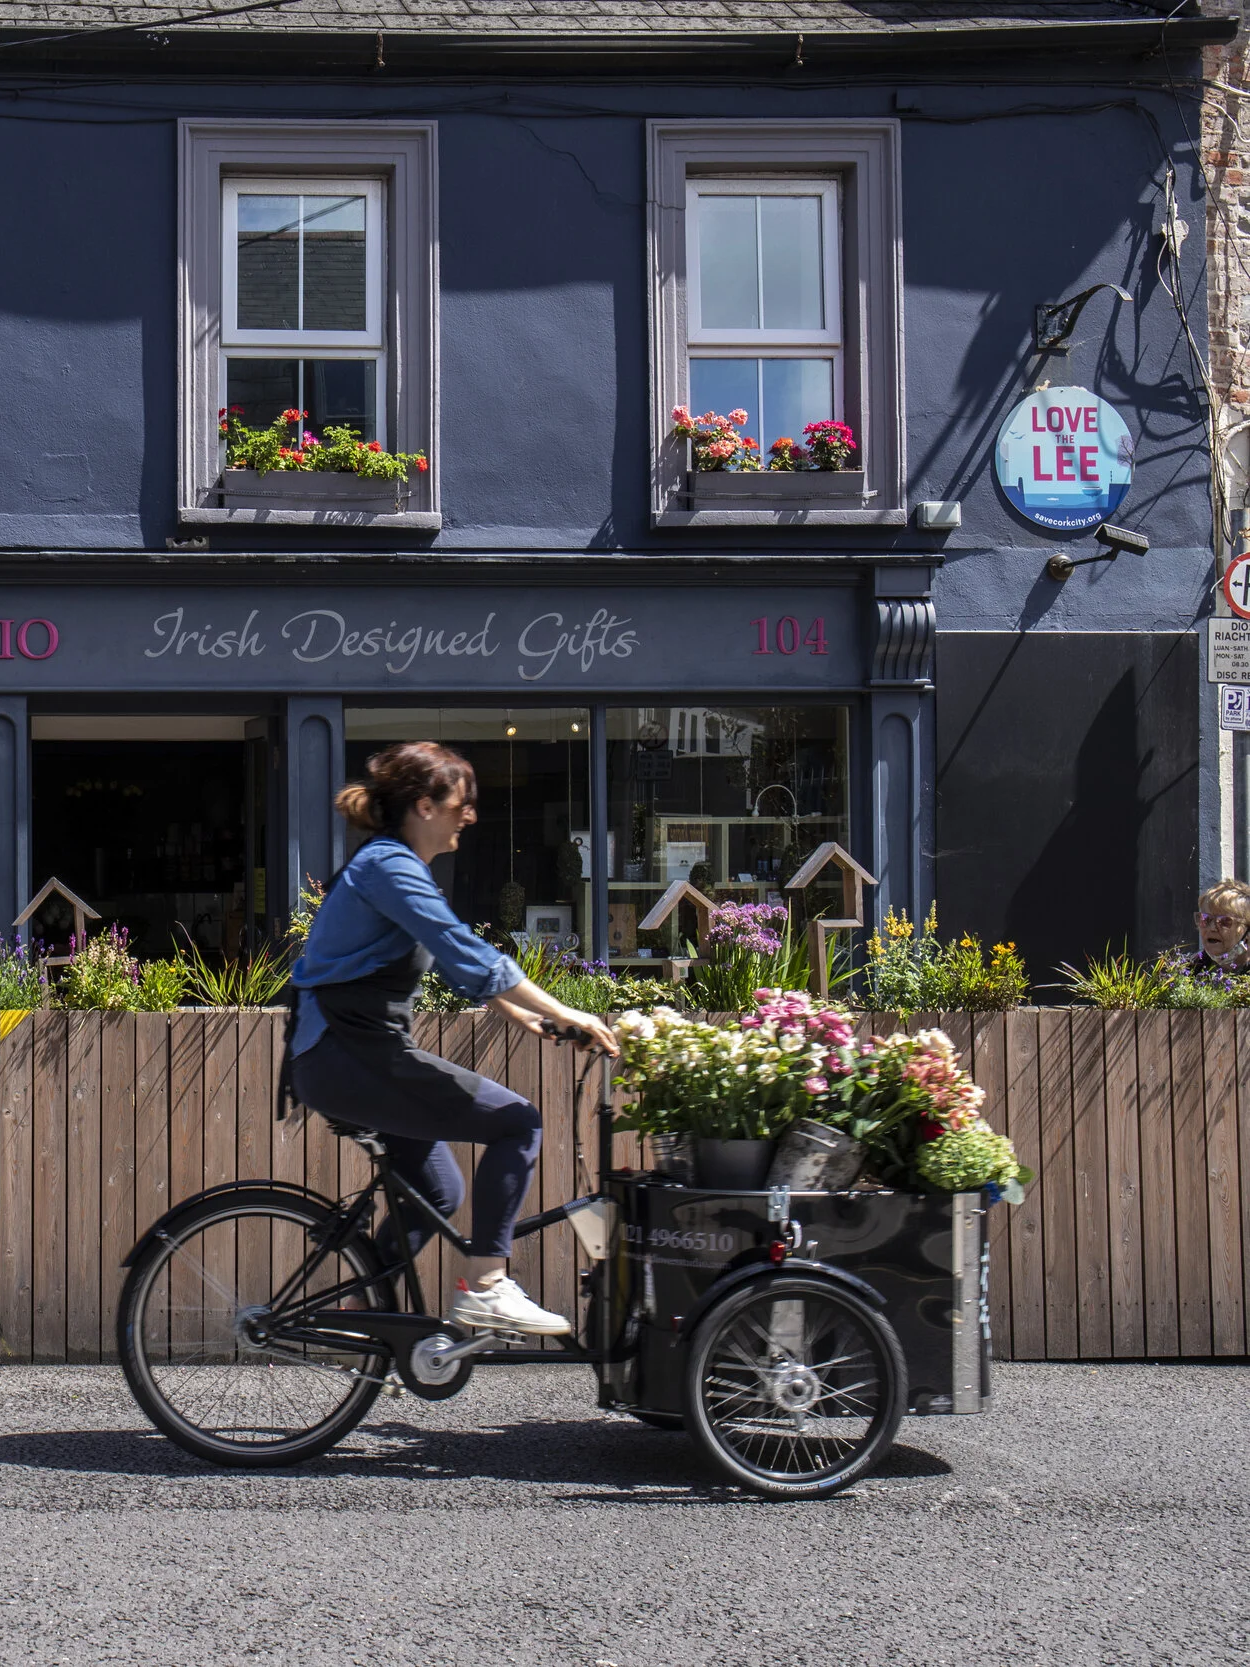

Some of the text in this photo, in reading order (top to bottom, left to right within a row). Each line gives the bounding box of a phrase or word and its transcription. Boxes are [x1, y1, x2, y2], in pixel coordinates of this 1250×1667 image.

[1031, 406, 1099, 433] LOVE
[1054, 434, 1075, 444] THE
[1033, 445, 1100, 482] LEE
[1034, 511, 1102, 527] savecorkcity.org
[145, 607, 641, 682] Irish Designed Gifts
[750, 615, 830, 656] 104
[1216, 671, 1238, 680] DISC
[646, 1228, 734, 1251] 4966510
